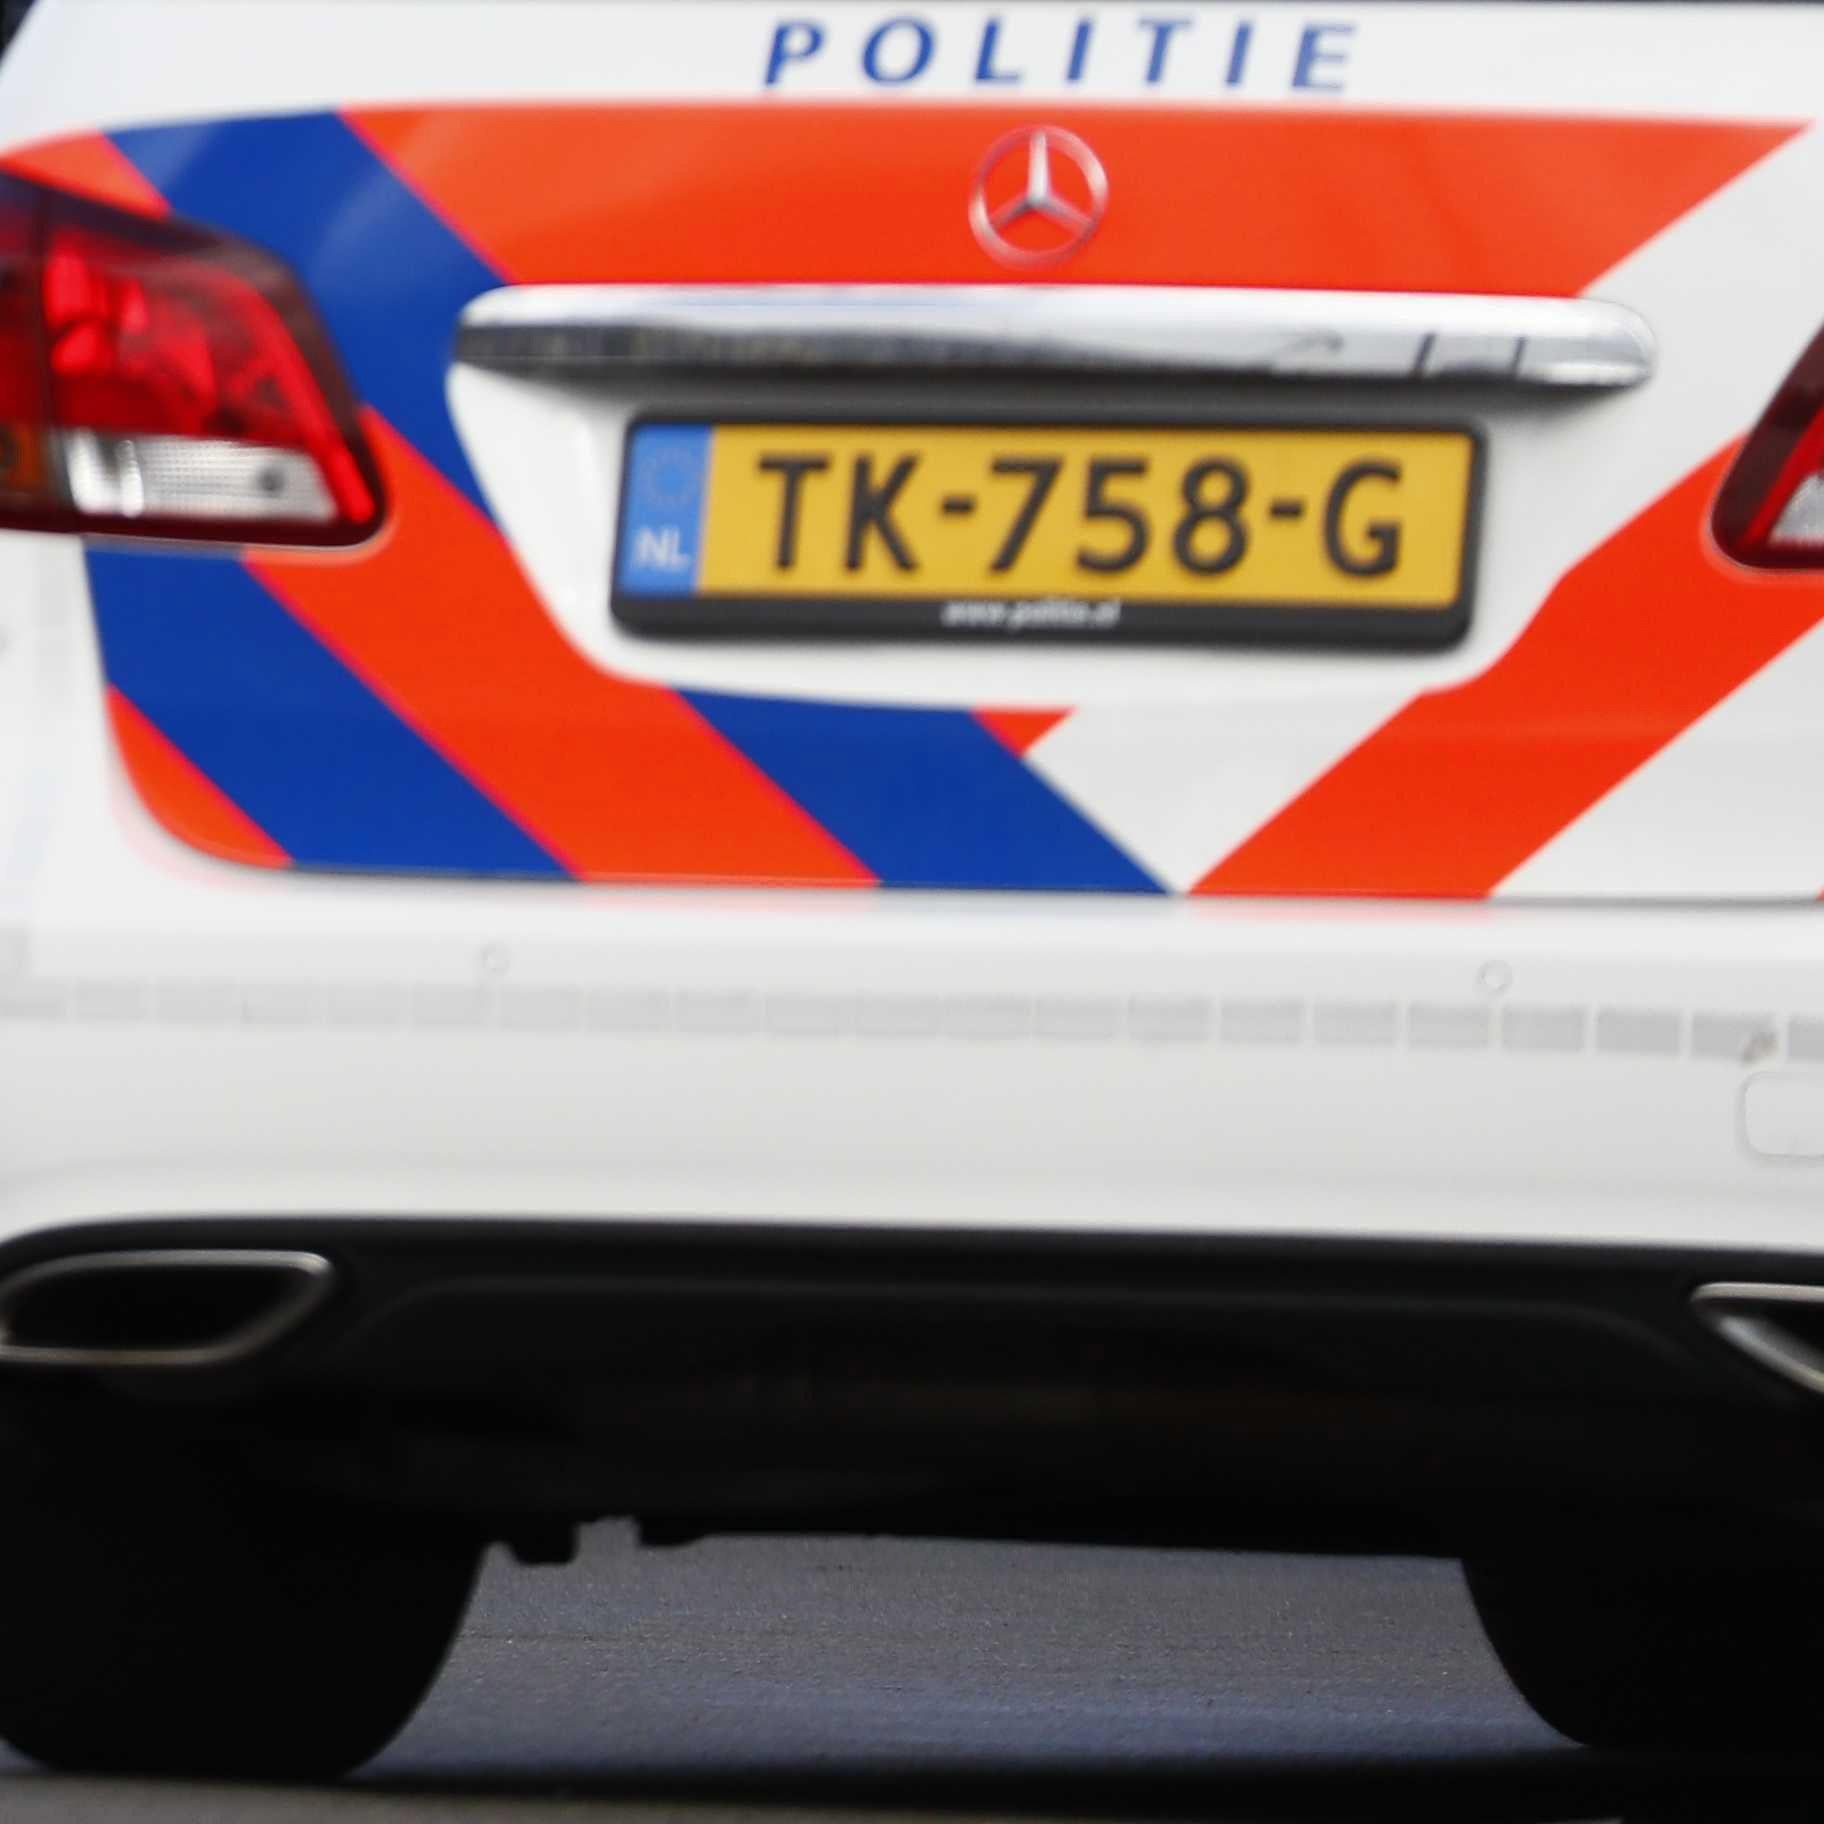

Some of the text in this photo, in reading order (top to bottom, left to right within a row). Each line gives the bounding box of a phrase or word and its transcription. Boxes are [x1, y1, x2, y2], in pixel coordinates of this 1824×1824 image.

[763, 13, 1358, 93] POLITIE
[632, 452, 1405, 578] NL TK-758-G
